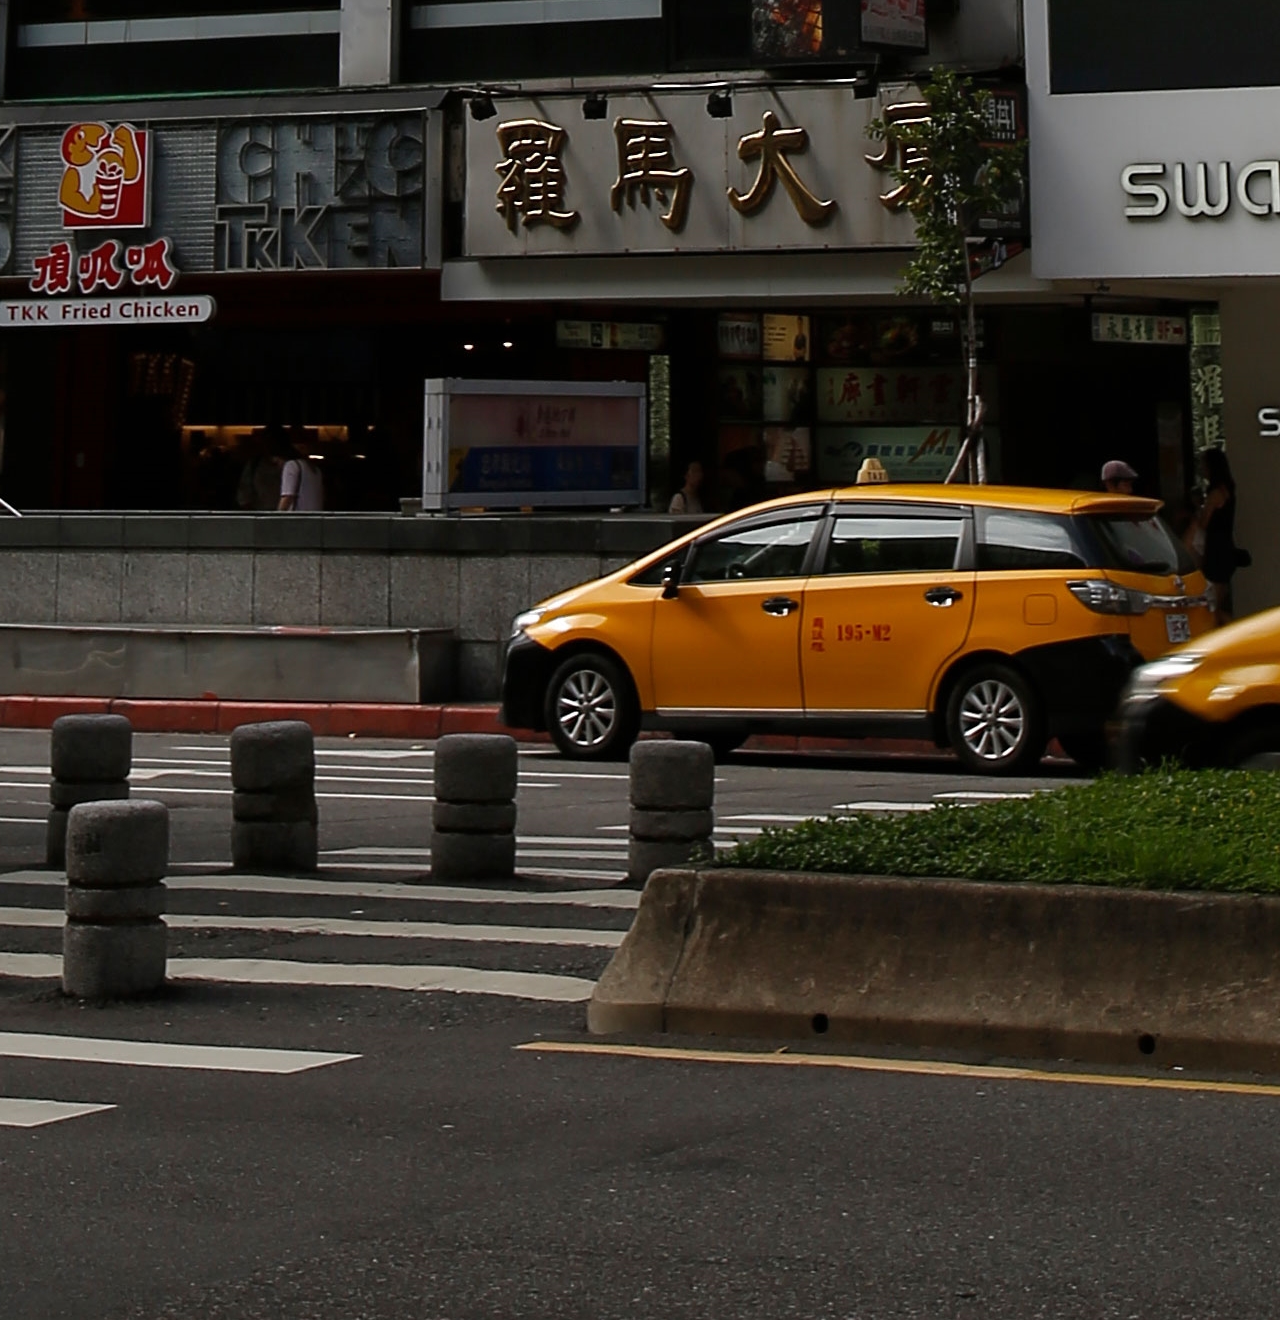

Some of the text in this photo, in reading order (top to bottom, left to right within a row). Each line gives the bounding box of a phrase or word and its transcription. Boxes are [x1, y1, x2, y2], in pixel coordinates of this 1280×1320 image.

[30, 235, 180, 296] 頂呱呱
[6, 298, 201, 323] TKK Fried Chicken
